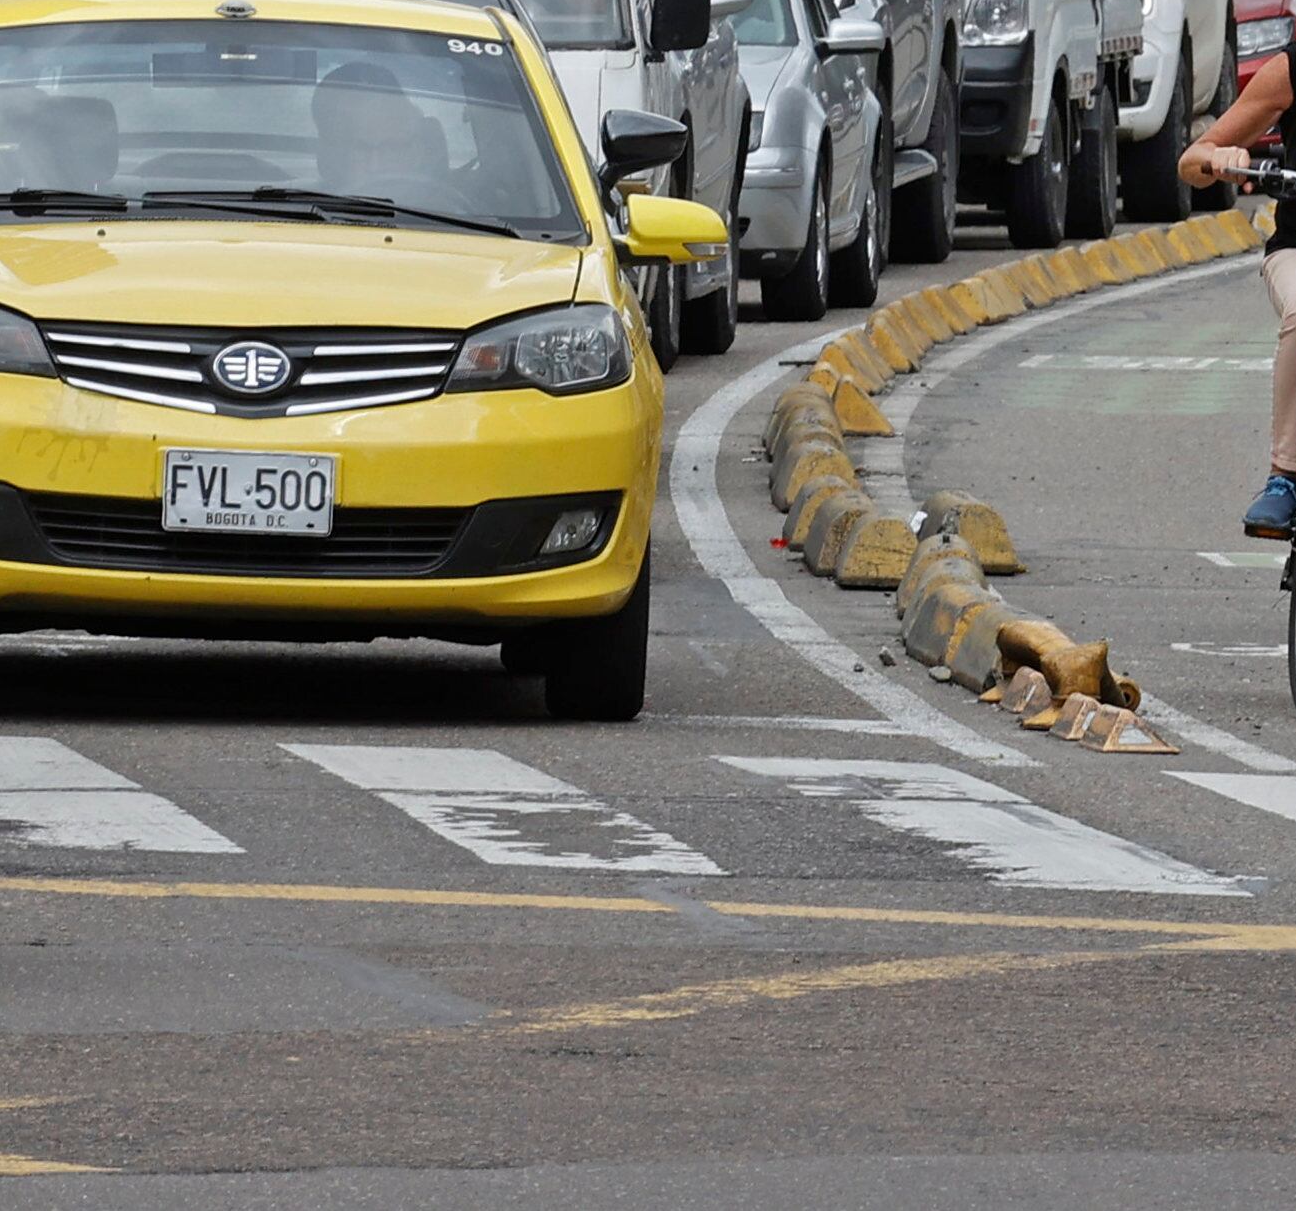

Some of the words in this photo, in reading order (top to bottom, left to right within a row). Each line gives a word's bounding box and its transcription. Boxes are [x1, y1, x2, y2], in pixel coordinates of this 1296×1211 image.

[447, 38, 504, 57] 940
[205, 511, 256, 527] BOGOTA
[266, 514, 289, 528] D.C.
